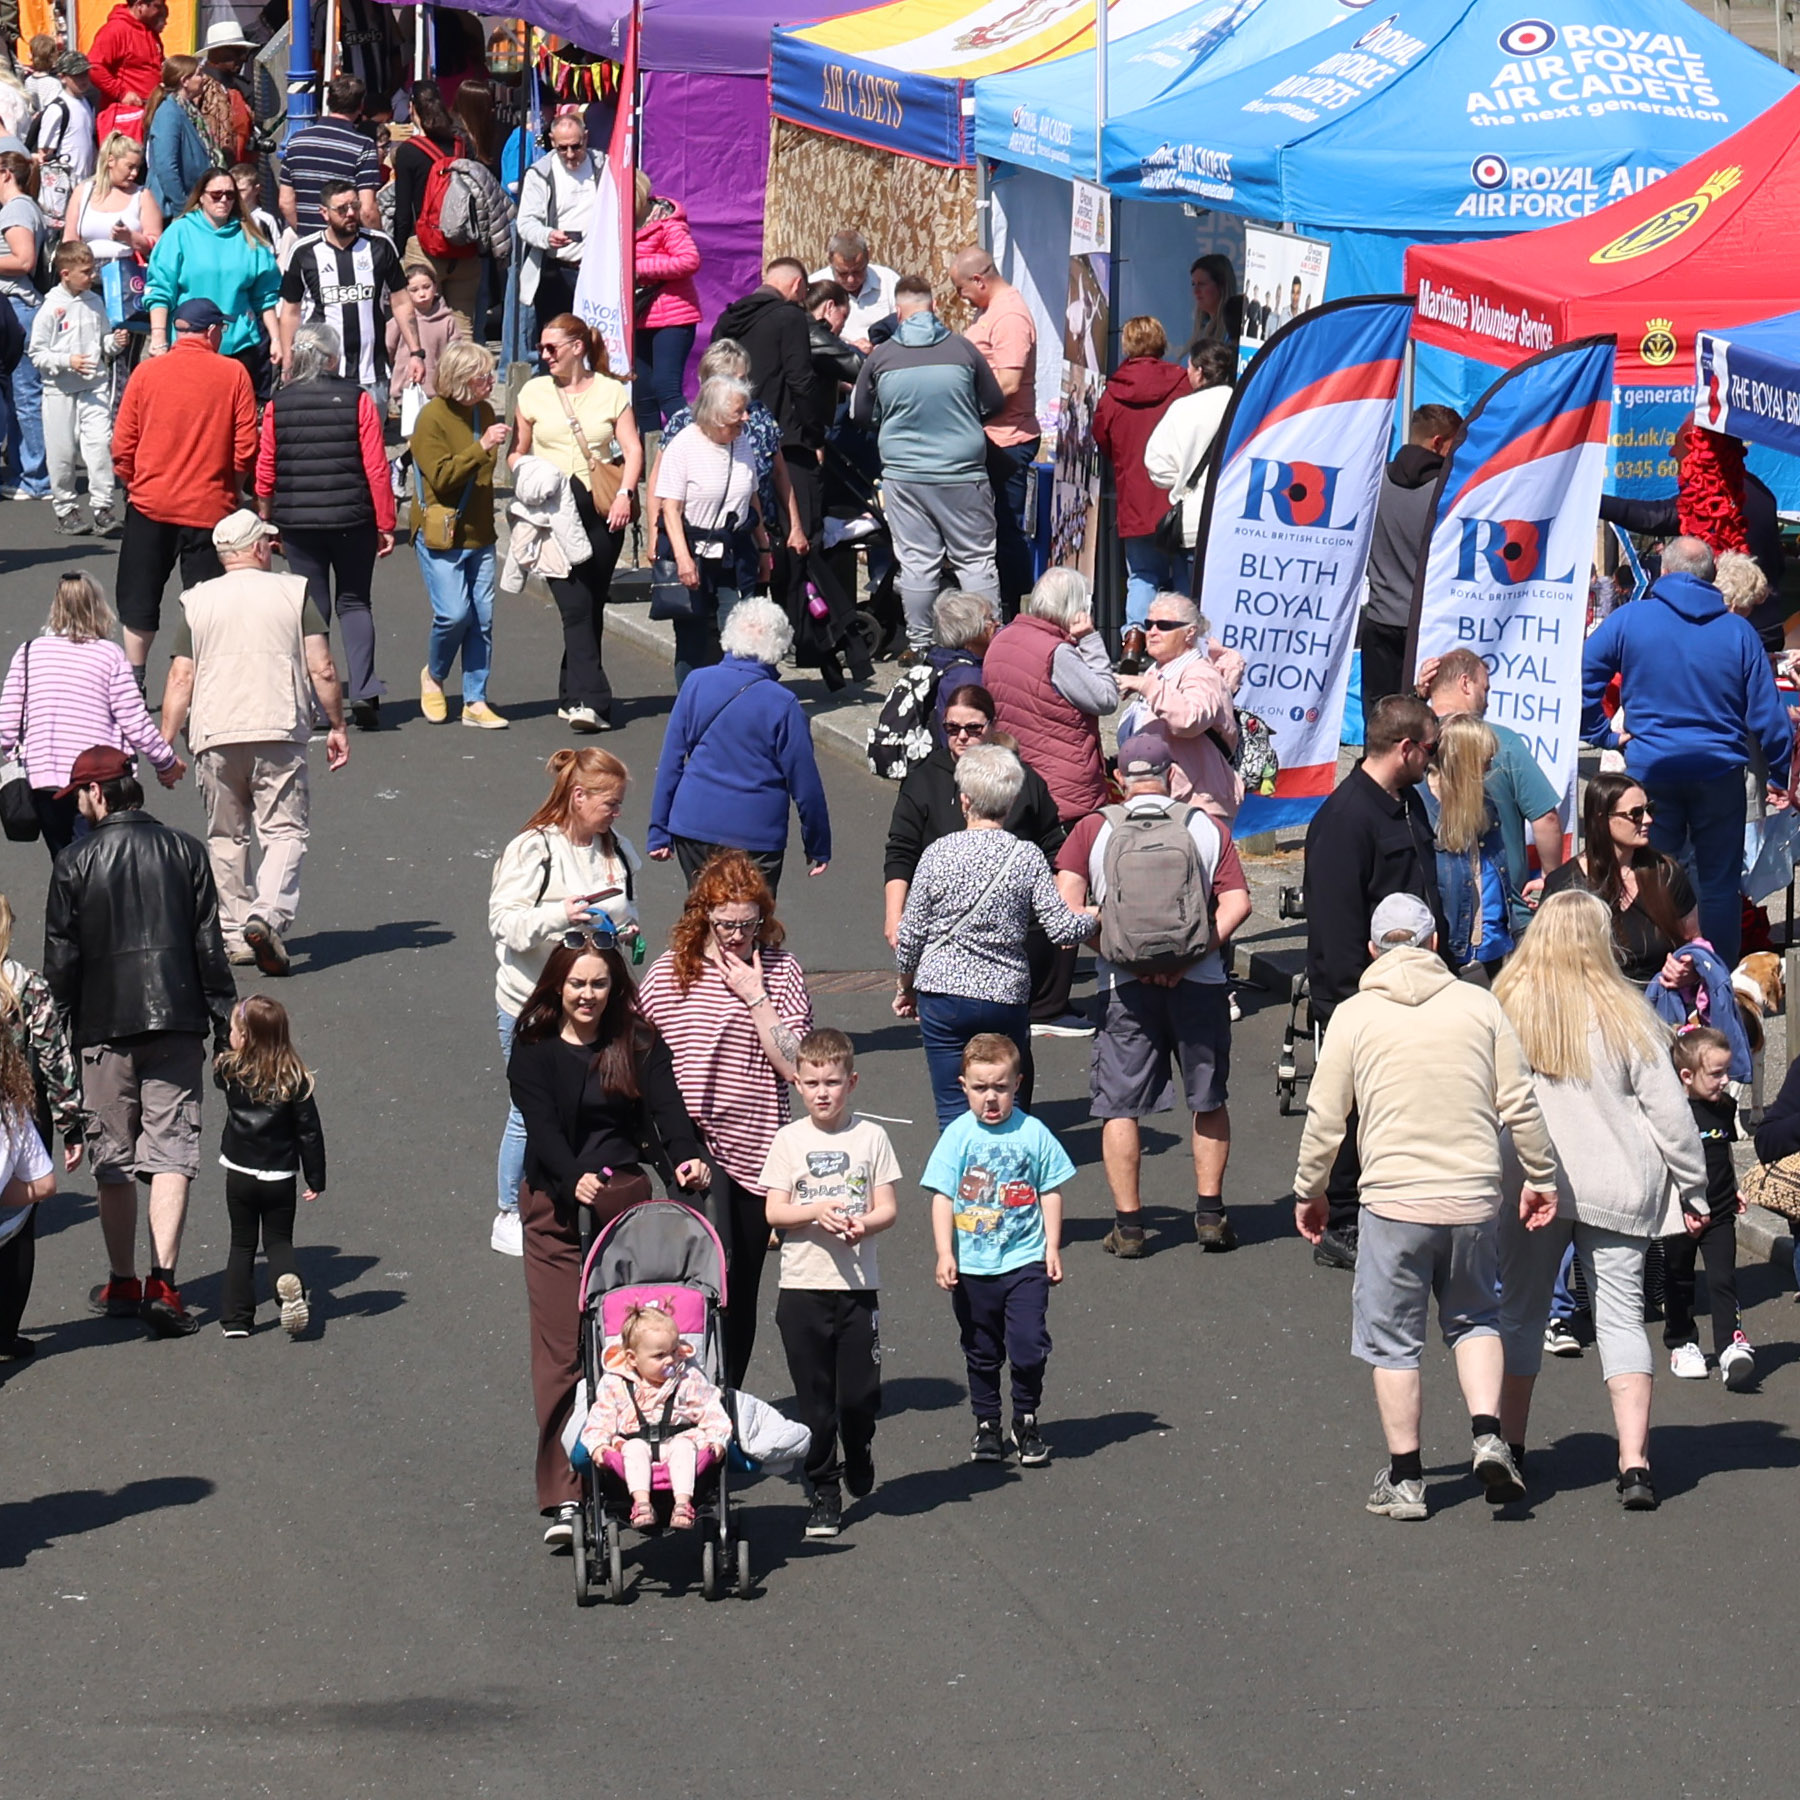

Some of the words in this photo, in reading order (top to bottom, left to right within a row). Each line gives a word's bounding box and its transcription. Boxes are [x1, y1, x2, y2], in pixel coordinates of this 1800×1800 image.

[1363, 27, 1427, 66] ROYAL
[1561, 25, 1701, 60] ROYAL
[1490, 55, 1570, 88] AIR
[1570, 49, 1711, 84] FORCE
[820, 63, 846, 113] AIR
[847, 69, 903, 129] CADETS
[1466, 86, 1541, 113] AIR
[1548, 74, 1720, 107] CADETS
[1469, 114, 1515, 126] the
[1522, 104, 1581, 123] next
[1586, 98, 1729, 123] generation
[1511, 167, 1598, 190] ROYAL
[1454, 194, 1507, 217] AIR
[1508, 194, 1599, 218] FORCE
[1418, 278, 1468, 330] Maritime
[1470, 294, 1519, 344] Volunteer
[1519, 308, 1553, 351] Service
[1731, 375, 1751, 412] THE
[1752, 381, 1785, 421] ROYAL
[1614, 460, 1653, 479] 0345
[1235, 527, 1268, 539] ROYAL
[1271, 531, 1312, 543] BRITISH
[1315, 537, 1354, 547] LEGION
[1239, 552, 1339, 586] BLYTH
[1235, 589, 1330, 621] ROYAL
[1450, 588, 1485, 601] ROYAL
[1488, 590, 1529, 601] BRITISH
[1532, 589, 1574, 601] LEGION
[1222, 624, 1333, 657] BRITISH
[1458, 615, 1560, 645] BLYTH
[1240, 662, 1329, 692] GION
[1482, 653, 1557, 684] OYAL
[1267, 707, 1284, 716] ON
[1490, 690, 1561, 724] TISH
